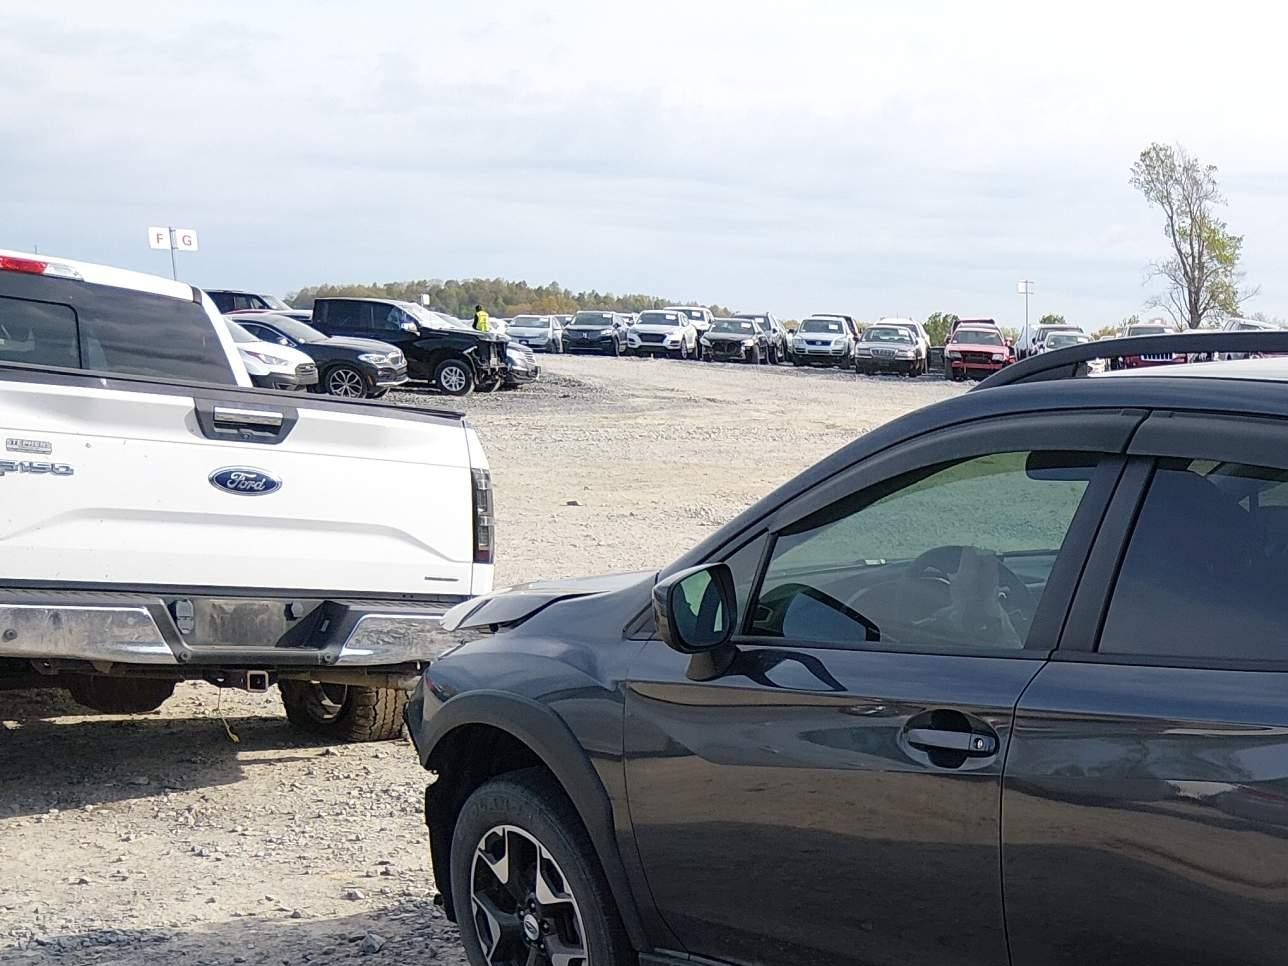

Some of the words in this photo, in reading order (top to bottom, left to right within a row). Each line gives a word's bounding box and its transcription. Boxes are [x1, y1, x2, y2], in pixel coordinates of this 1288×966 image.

[156, 232, 165, 244] F
[182, 234, 192, 246] G
[226, 471, 266, 490] Ford
